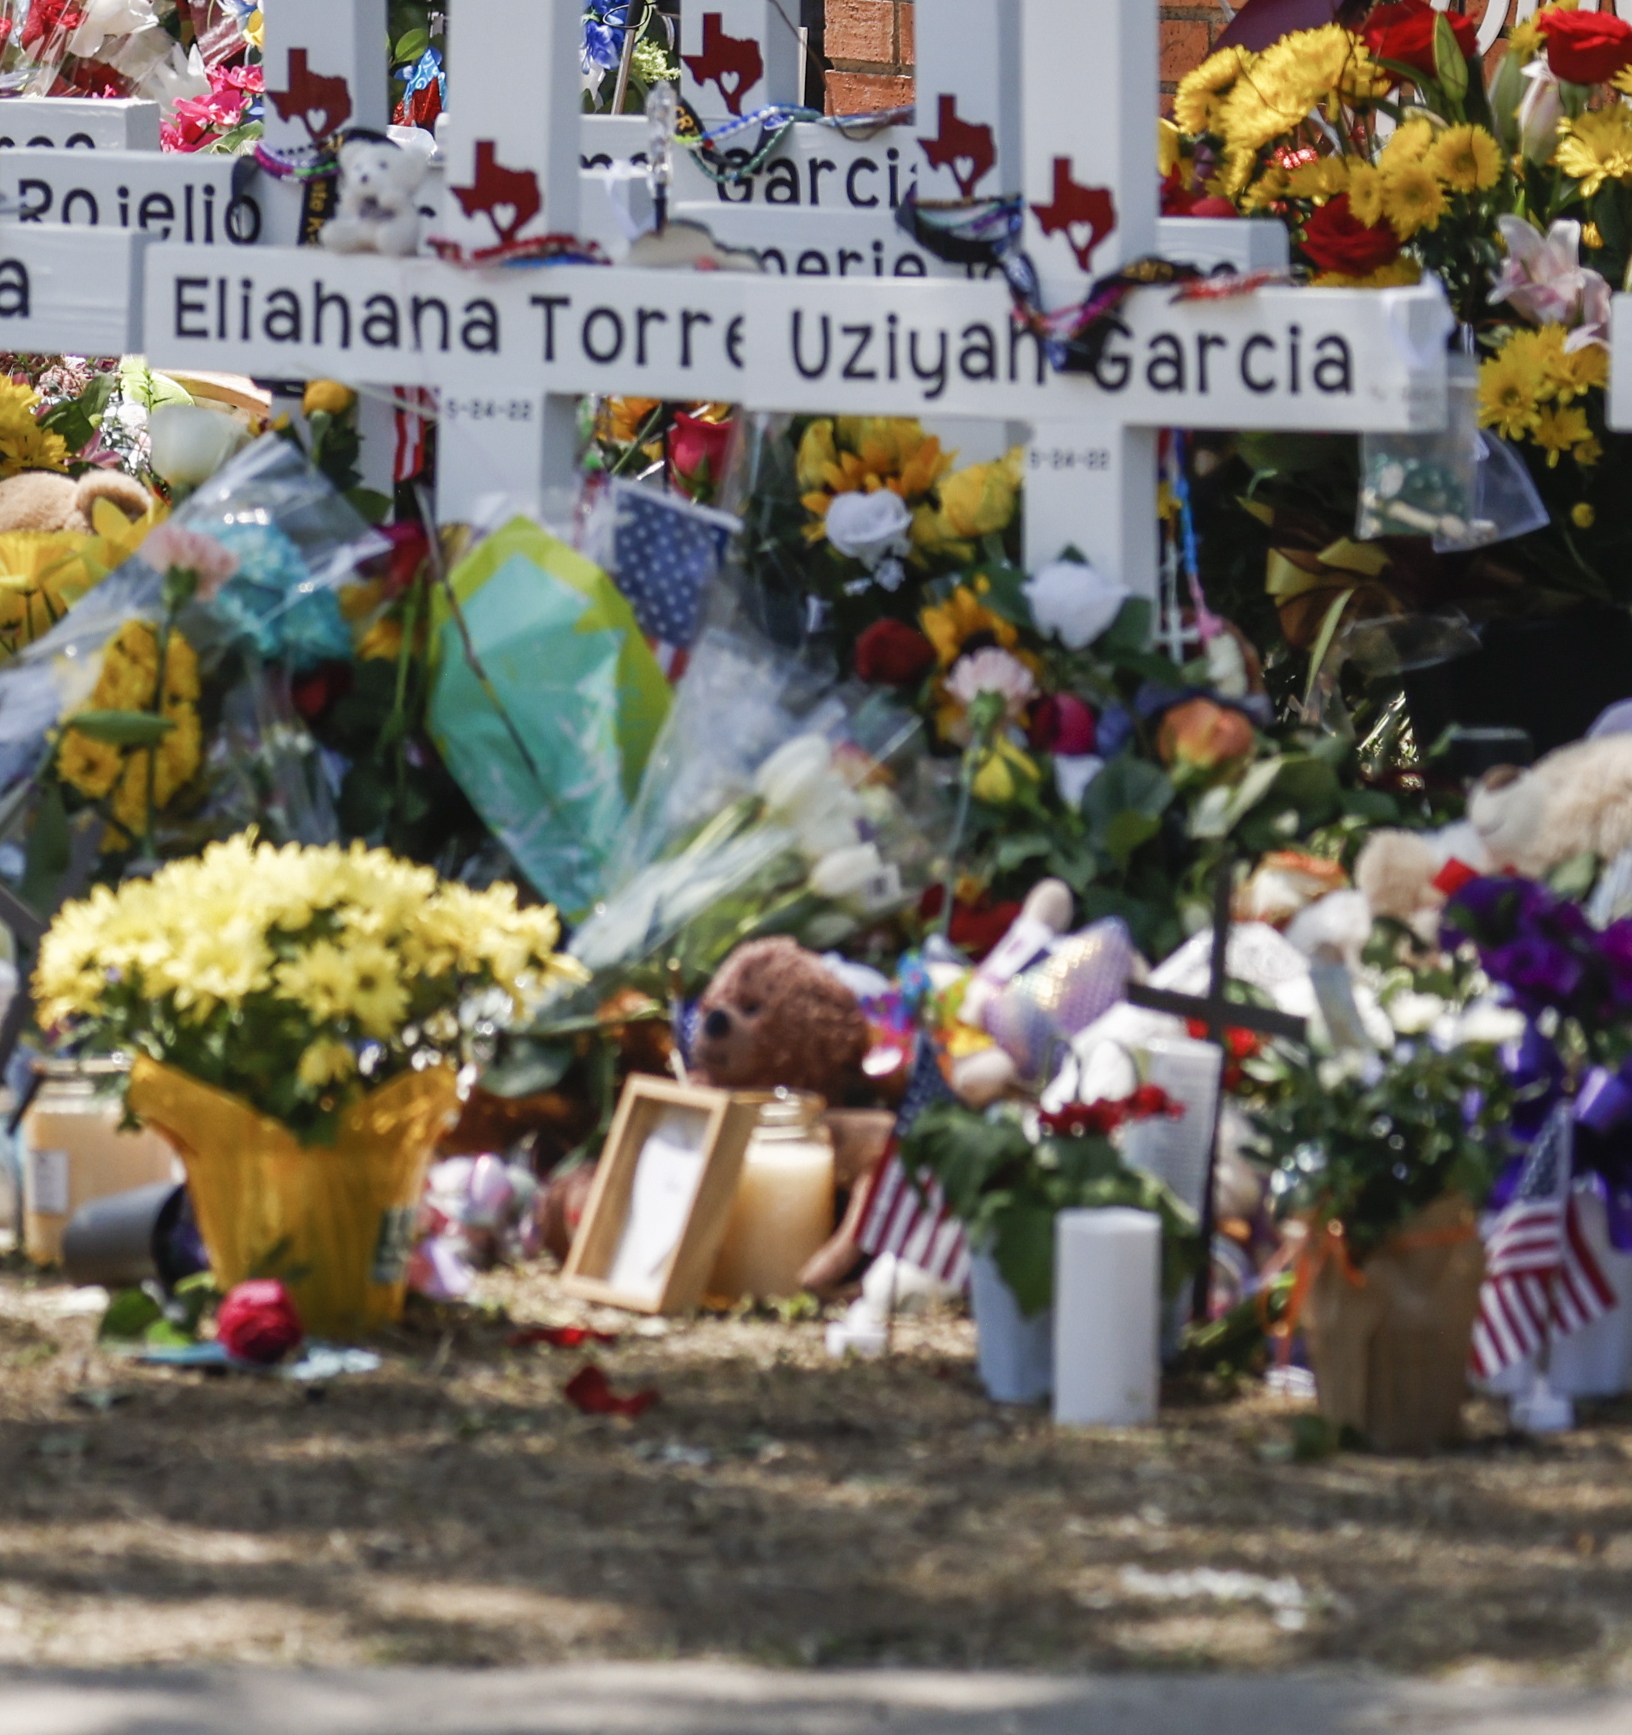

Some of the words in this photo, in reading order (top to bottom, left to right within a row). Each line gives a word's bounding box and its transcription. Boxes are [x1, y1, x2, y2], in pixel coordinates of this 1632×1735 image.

[717, 147, 917, 209] Garci
[174, 276, 500, 354] Eliahana
[529, 294, 744, 369] Torre
[791, 306, 1047, 401] Uziyah
[1095, 315, 1353, 395] Garcia
